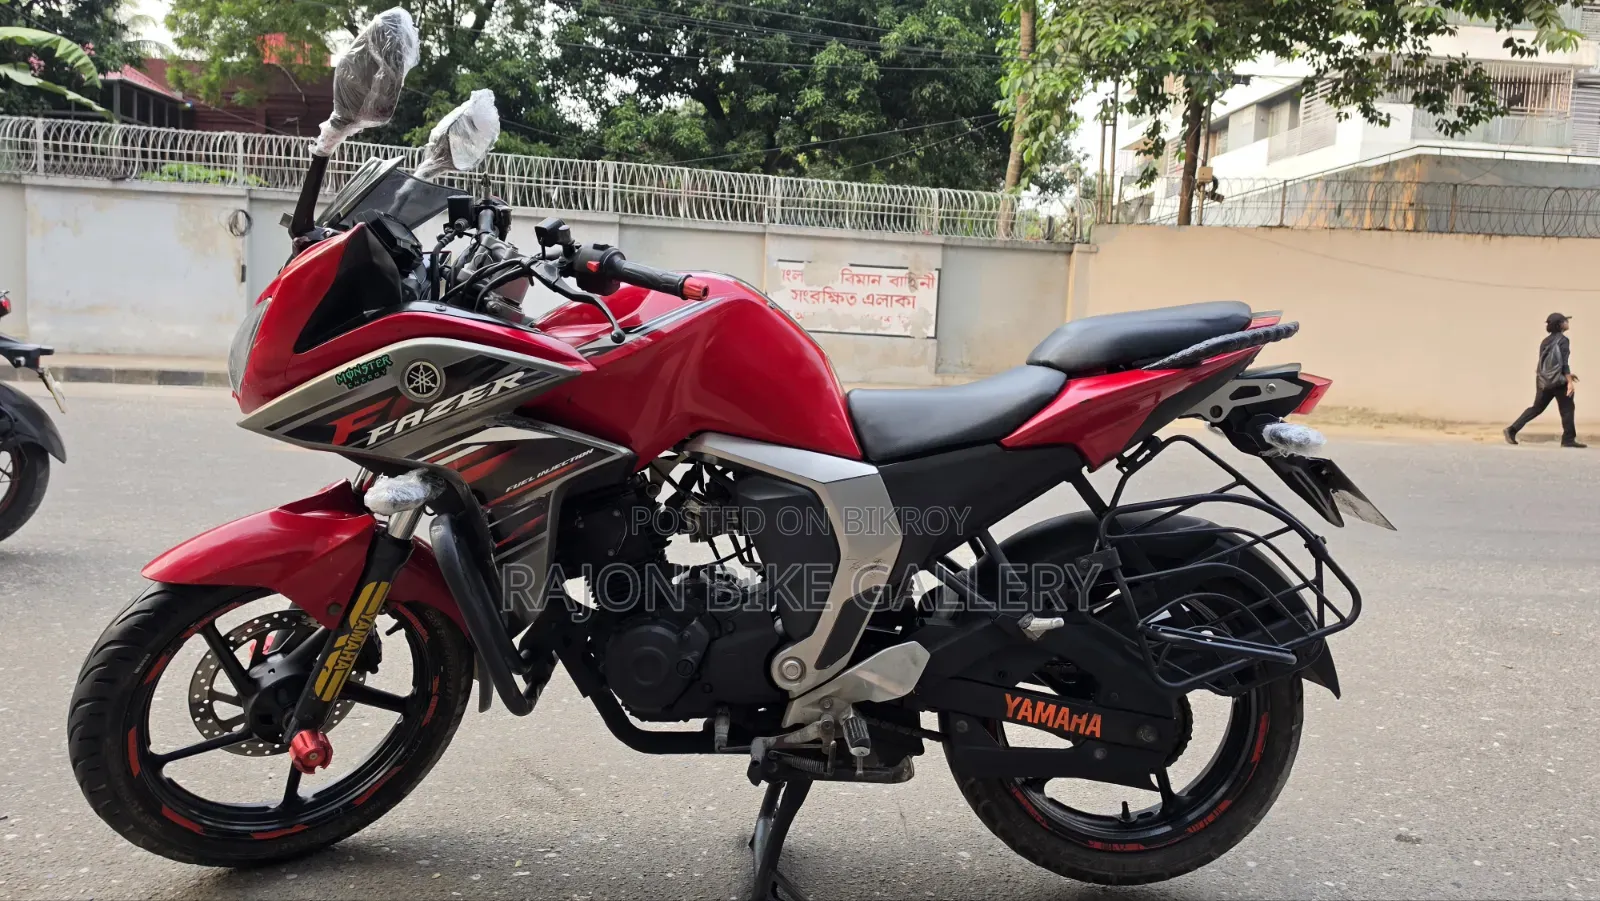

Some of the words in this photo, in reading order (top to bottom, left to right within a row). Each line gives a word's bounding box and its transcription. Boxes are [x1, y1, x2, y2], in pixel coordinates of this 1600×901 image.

[791, 286, 858, 306] সংরক্ষিত
[862, 293, 917, 310] এলাকা
[841, 268, 882, 286] বিমান
[366, 371, 525, 446] FAZER
[505, 477, 535, 493] FUEL
[537, 448, 595, 478] INJECTION
[334, 613, 376, 671] YAMAHA
[1004, 693, 1102, 738] YAMAHA
